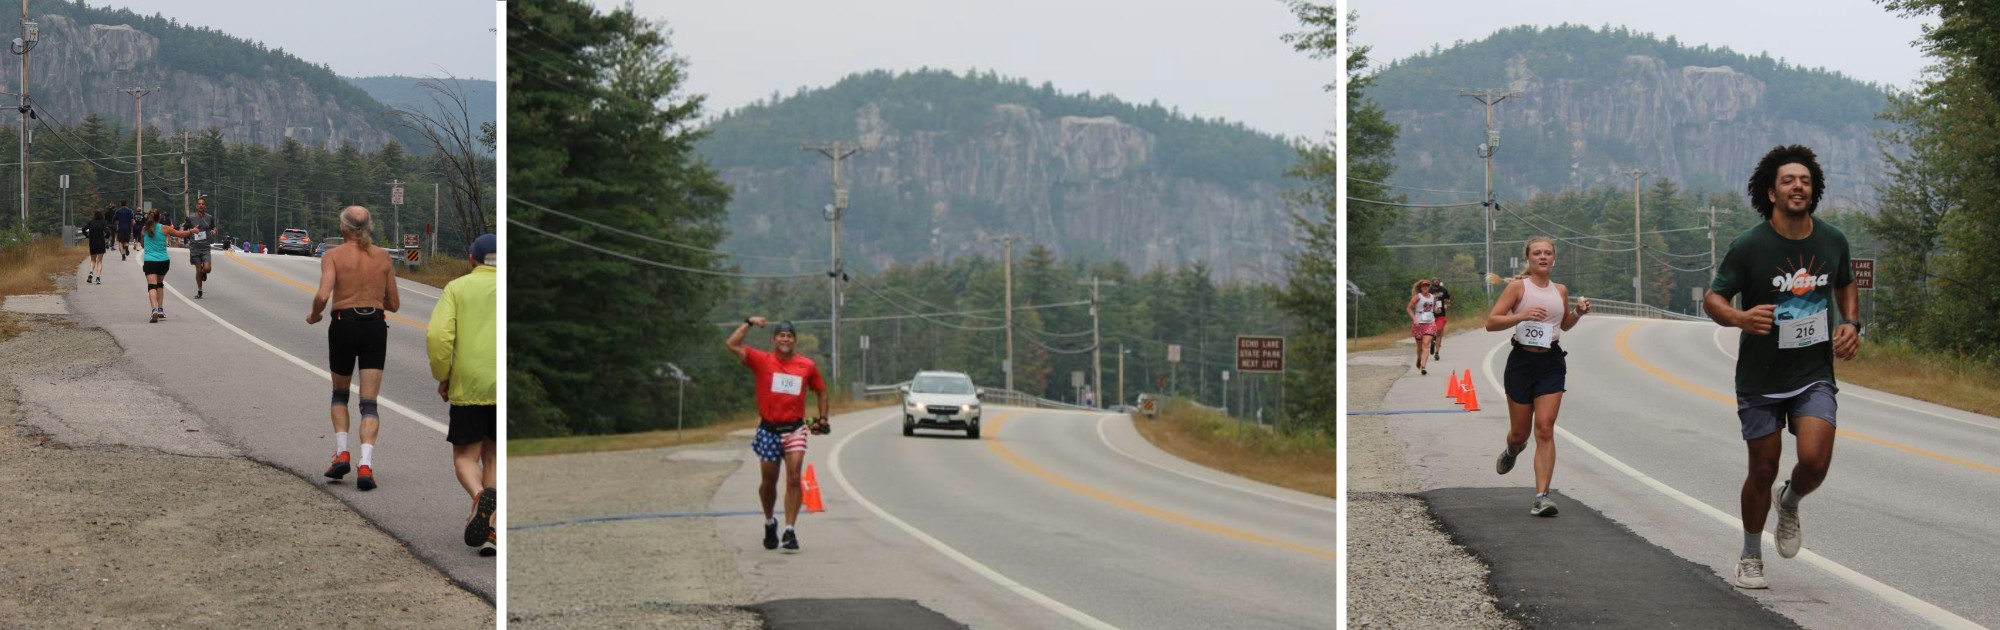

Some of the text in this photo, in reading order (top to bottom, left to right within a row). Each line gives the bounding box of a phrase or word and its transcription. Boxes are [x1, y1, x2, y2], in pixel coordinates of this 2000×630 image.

[1855, 270, 1872, 278] PARK
[1772, 268, 1828, 292] Wana
[1525, 328, 1544, 338] 209
[1795, 325, 1815, 338] 216
[1241, 340, 1280, 349] ECHO LAKE
[1240, 350, 1281, 359] STATE PARK
[1242, 360, 1278, 369] NEXT LEFT
